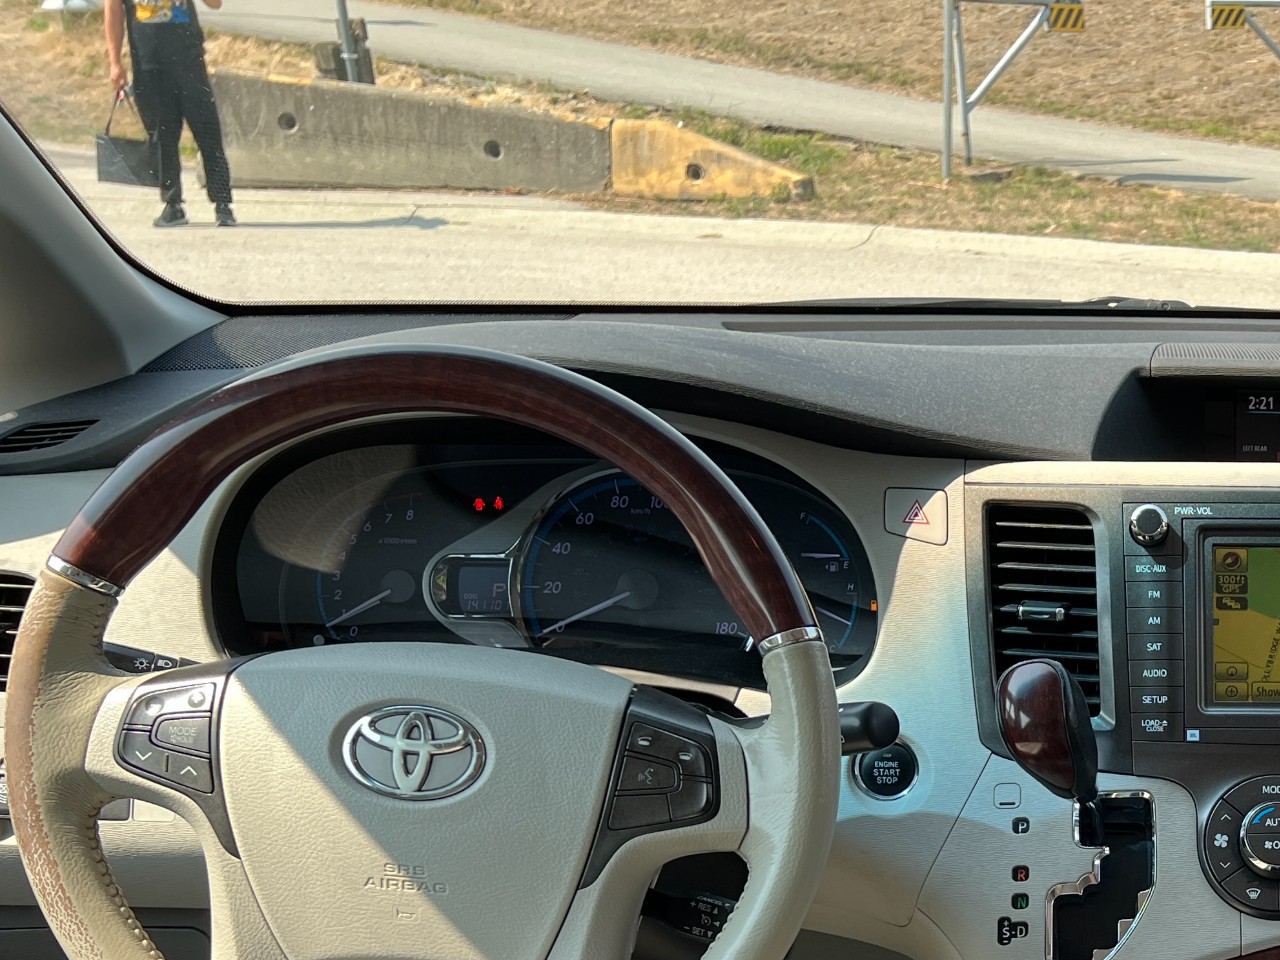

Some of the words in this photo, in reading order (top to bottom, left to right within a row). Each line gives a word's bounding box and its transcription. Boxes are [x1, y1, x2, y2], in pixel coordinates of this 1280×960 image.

[1248, 396, 1273, 410] 2:21
[610, 496, 629, 508] 80
[385, 513, 393, 524] 7
[406, 509, 414, 521] 8
[575, 512, 594, 526] 60
[364, 521, 372, 532] 6
[350, 534, 357, 545] 5
[552, 542, 571, 555] 40
[333, 570, 341, 581] 3
[493, 583, 507, 598] P
[544, 581, 562, 595] 20
[847, 583, 855, 591] H
[334, 589, 342, 600] 2
[1148, 591, 1161, 599] FM
[1148, 617, 1161, 625] AM
[350, 626, 359, 637] 0
[715, 622, 738, 635] 180
[1146, 643, 1162, 652] SAT
[1142, 668, 1168, 678] AUDIO
[1256, 687, 1280, 698] Show
[1141, 696, 1168, 705] SETUP
[1018, 821, 1028, 833] P
[384, 862, 427, 876] SRS
[1017, 870, 1026, 880] R
[364, 876, 449, 894] AIRBAG
[1017, 897, 1026, 908] N
[691, 926, 706, 936] SET
